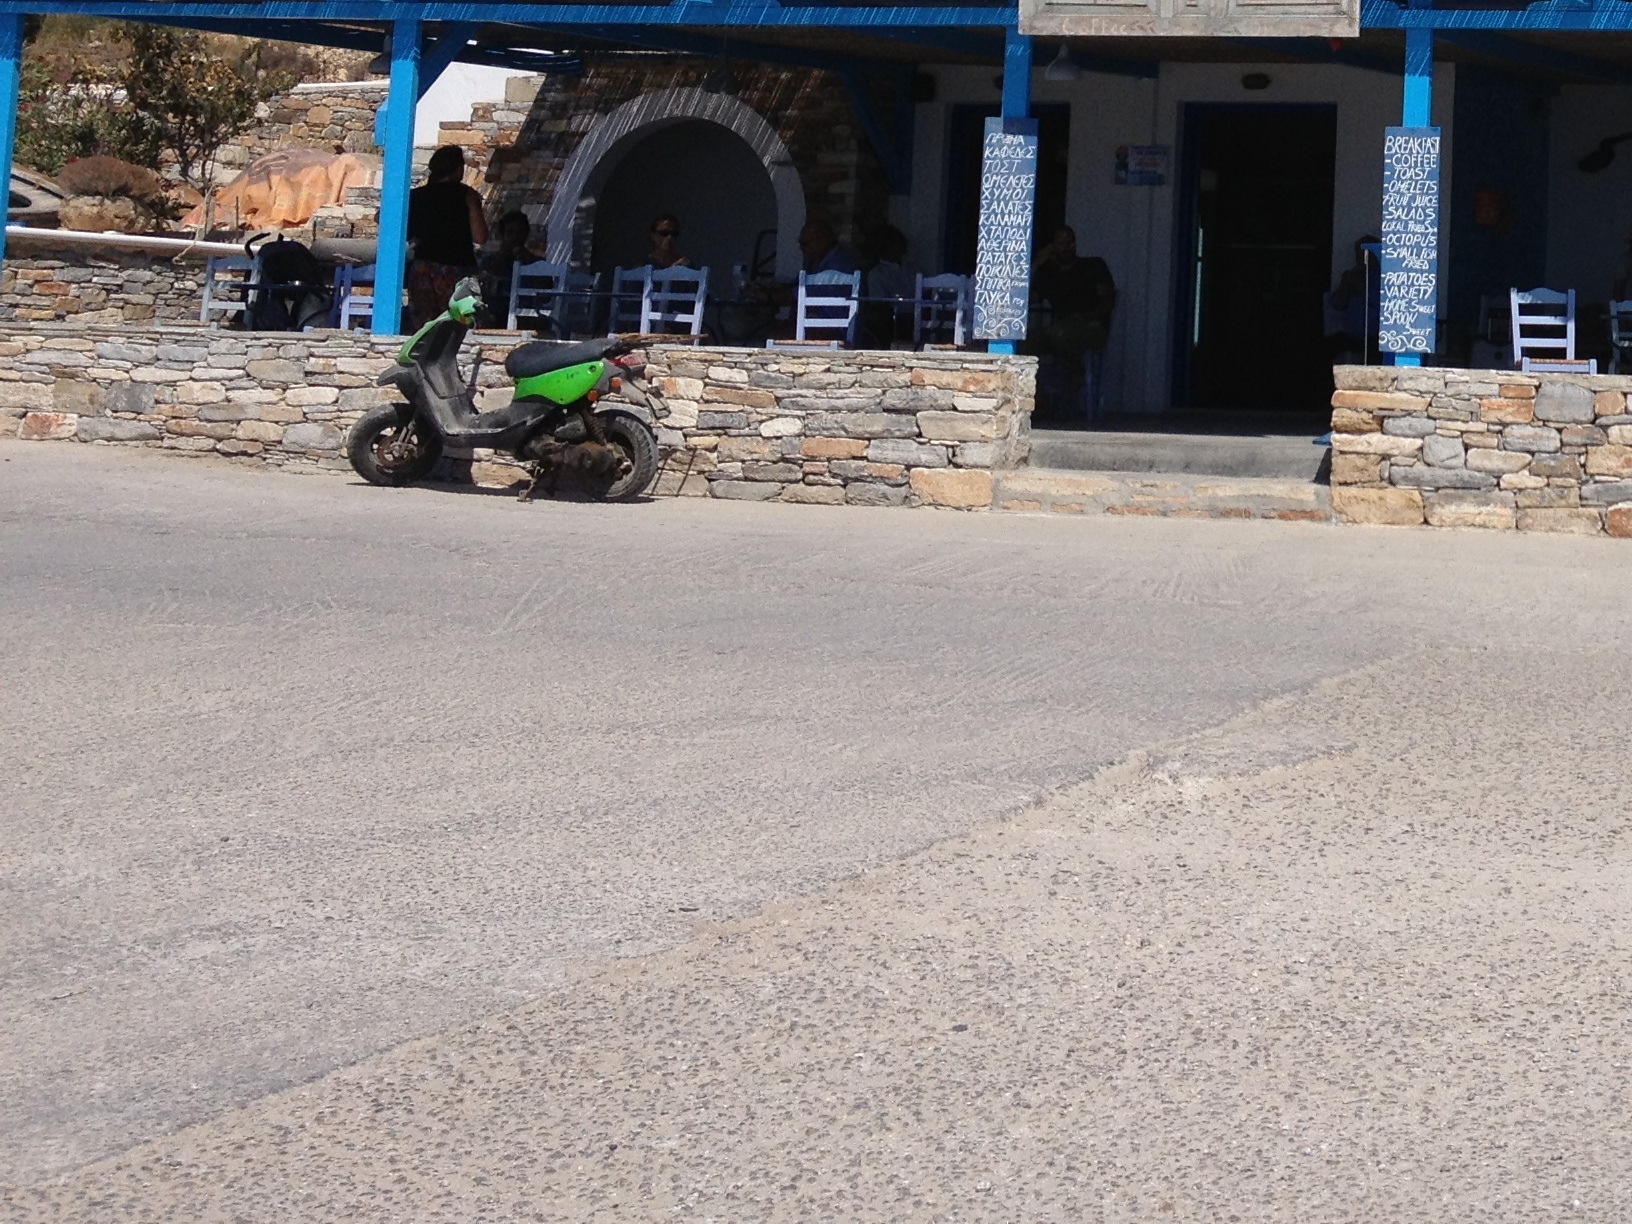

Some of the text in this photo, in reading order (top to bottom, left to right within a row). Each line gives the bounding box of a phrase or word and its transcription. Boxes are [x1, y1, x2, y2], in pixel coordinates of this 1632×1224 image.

[1384, 136, 1440, 154] BREAKFAST
[984, 159, 1022, 174] ΤΟΣΤ
[981, 186, 1028, 200] ΧΥΜΟΙ
[980, 200, 1033, 214] ΣΑΛΑΤΕΣ
[978, 226, 1030, 240] ΧΤΑΠΟΔΙ
[974, 290, 1010, 305] ΓΛΥΚΑ
